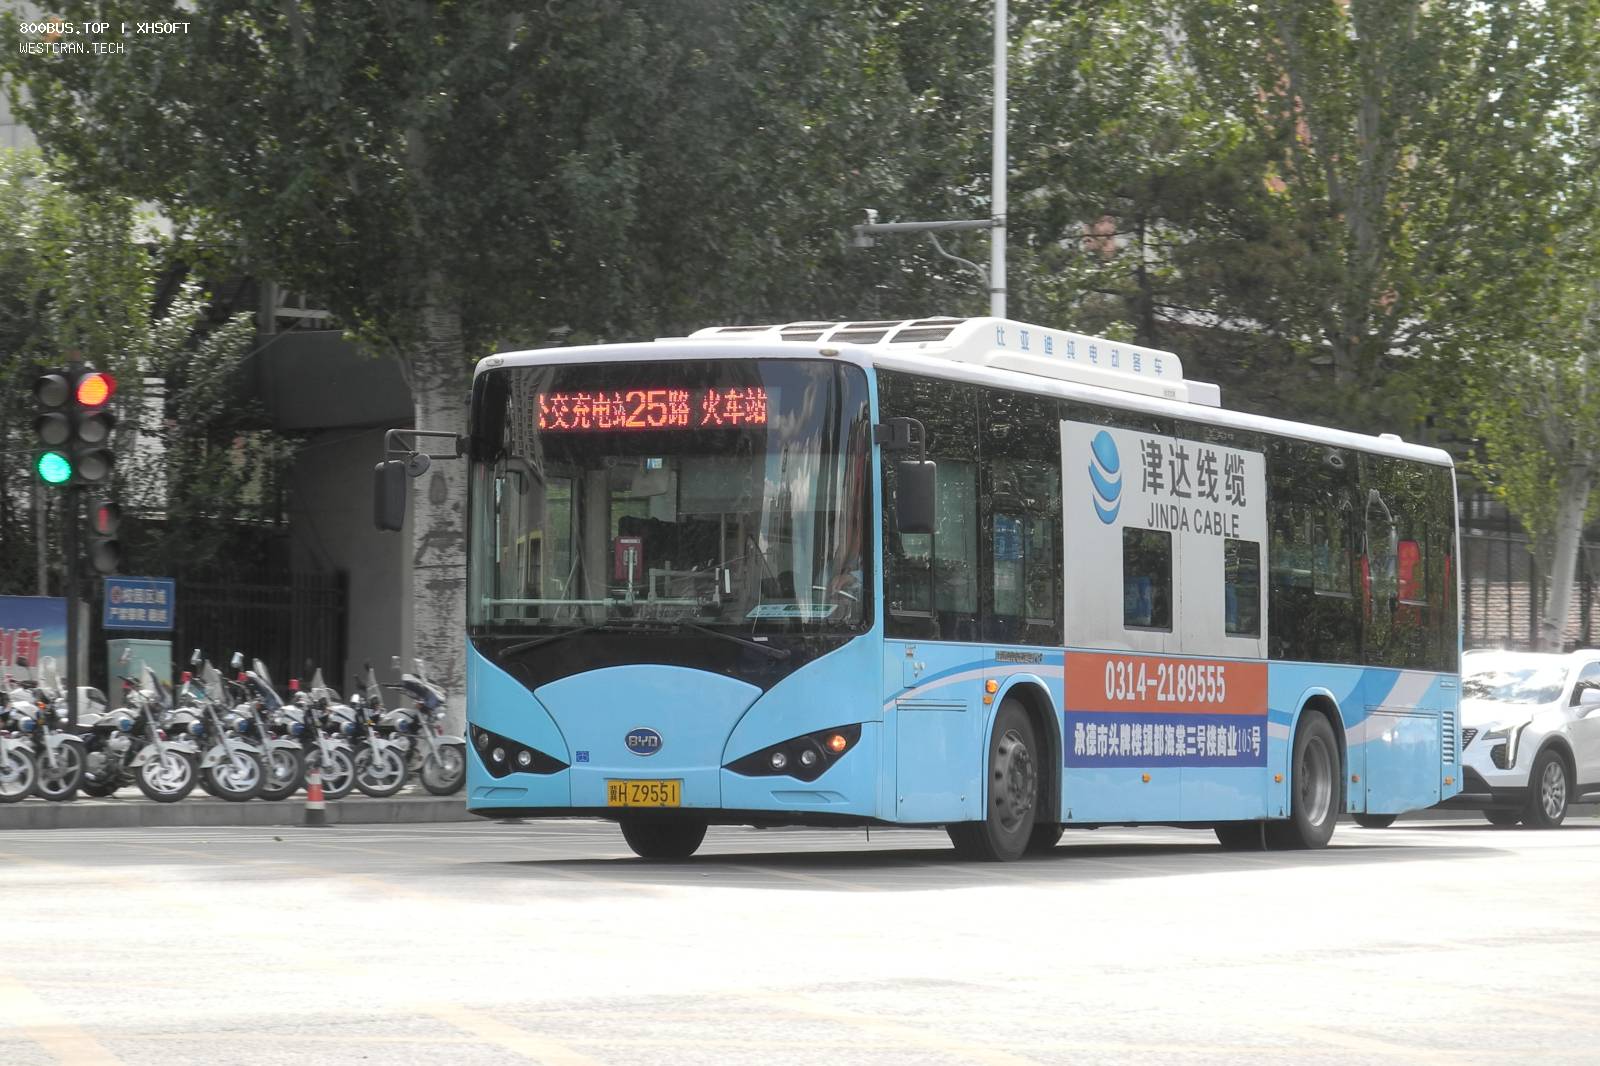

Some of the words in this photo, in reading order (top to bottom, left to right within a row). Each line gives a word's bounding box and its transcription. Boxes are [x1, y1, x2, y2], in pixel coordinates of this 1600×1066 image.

[701, 387, 768, 426] 火车站
[1140, 439, 1246, 507] 津达线缆
[1147, 502, 1189, 532] JINDA
[1194, 508, 1239, 538] CABLE
[1105, 660, 1226, 703] 0314-2189555
[628, 735, 658, 747] BYD
